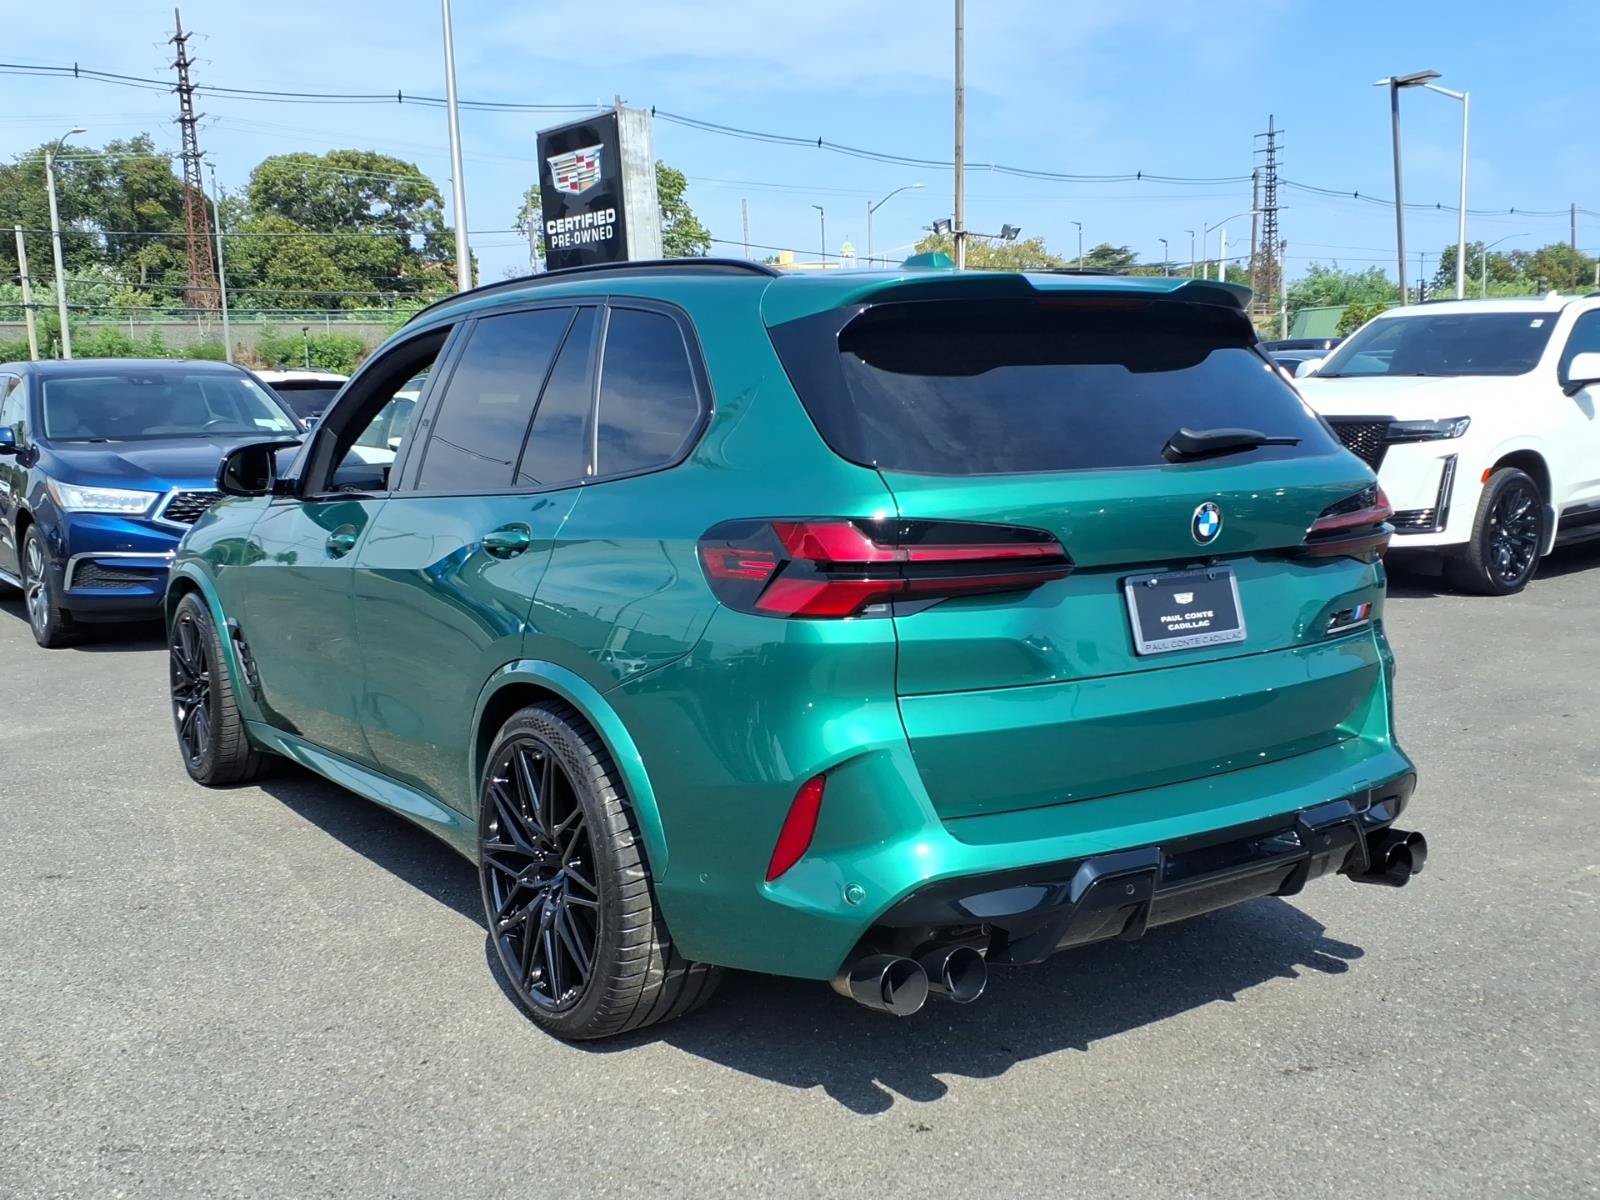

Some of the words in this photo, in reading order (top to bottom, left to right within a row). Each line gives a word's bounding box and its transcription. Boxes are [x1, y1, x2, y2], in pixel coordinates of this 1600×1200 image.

[546, 208, 616, 235] CERTIFIED
[551, 225, 613, 249] PRE-OWNED
[1160, 614, 1183, 623] PAUL
[1184, 610, 1214, 620] CONTE
[1167, 620, 1210, 631] CADILLAC
[1145, 643, 1168, 652] PAUL
[1171, 637, 1201, 648] CONTE
[1202, 631, 1243, 643] CADILLAC
